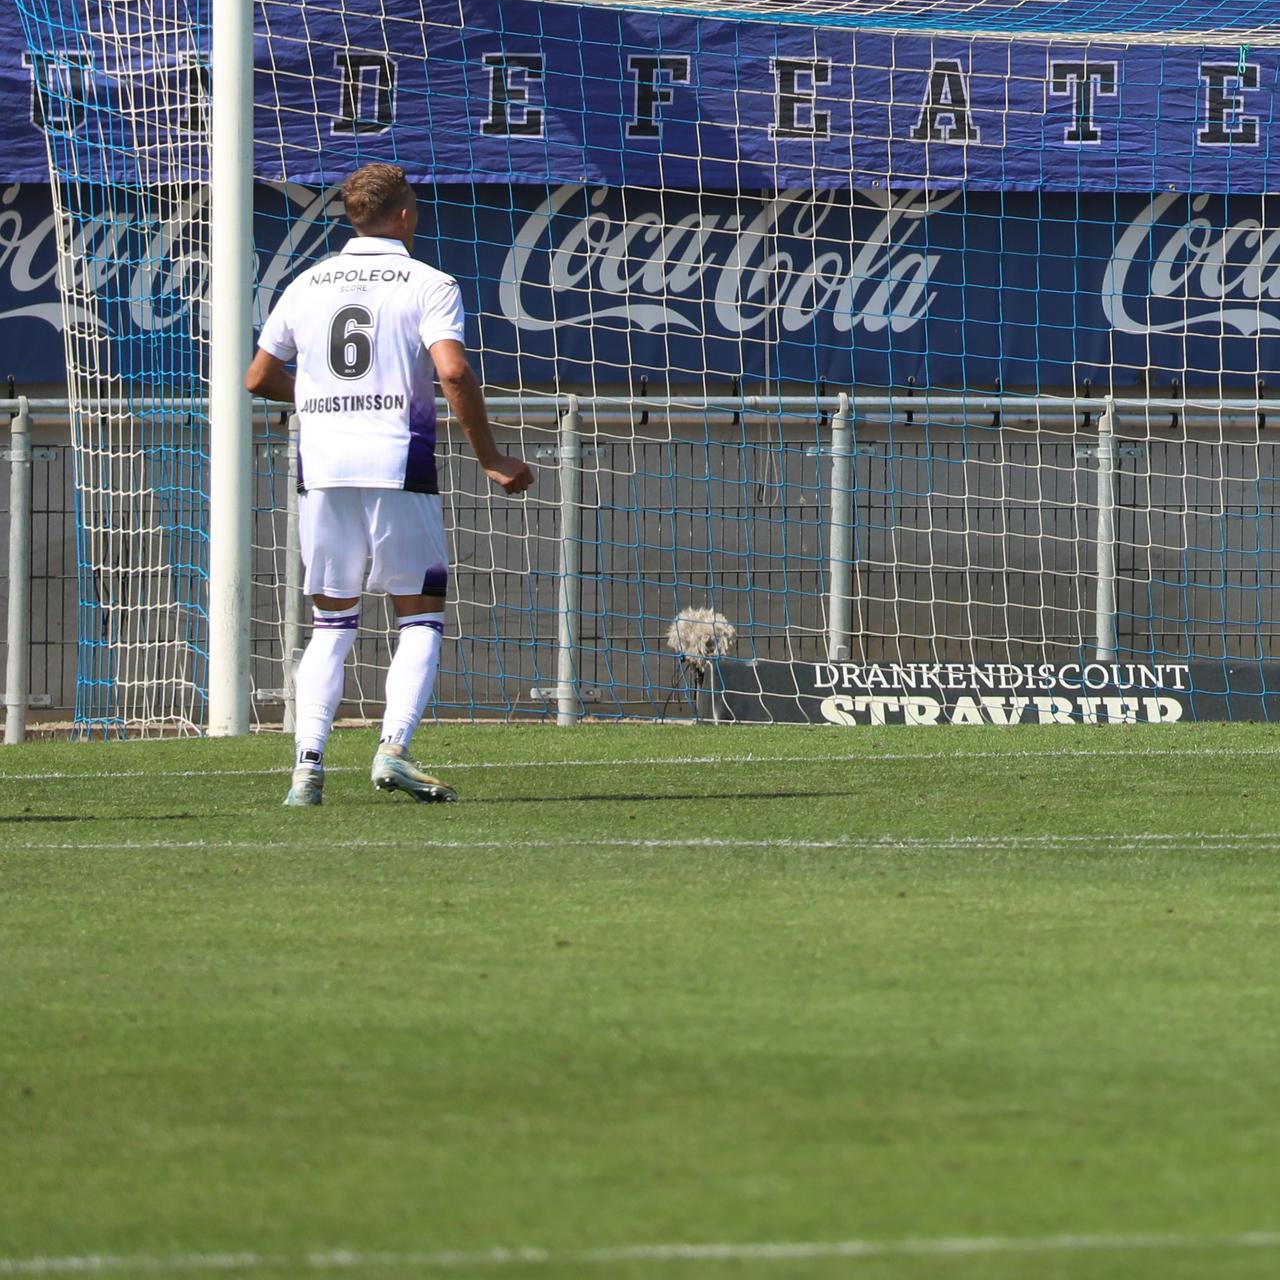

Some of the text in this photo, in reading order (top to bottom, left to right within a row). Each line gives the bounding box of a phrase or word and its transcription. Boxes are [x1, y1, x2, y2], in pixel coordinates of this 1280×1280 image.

[310, 269, 411, 288] NAPOLEON
[340, 284, 368, 293] SCORE
[327, 304, 374, 381] 6
[301, 394, 404, 414] AUGUSTINSSON
[814, 663, 1189, 690] DRANKENDISCOUNT
